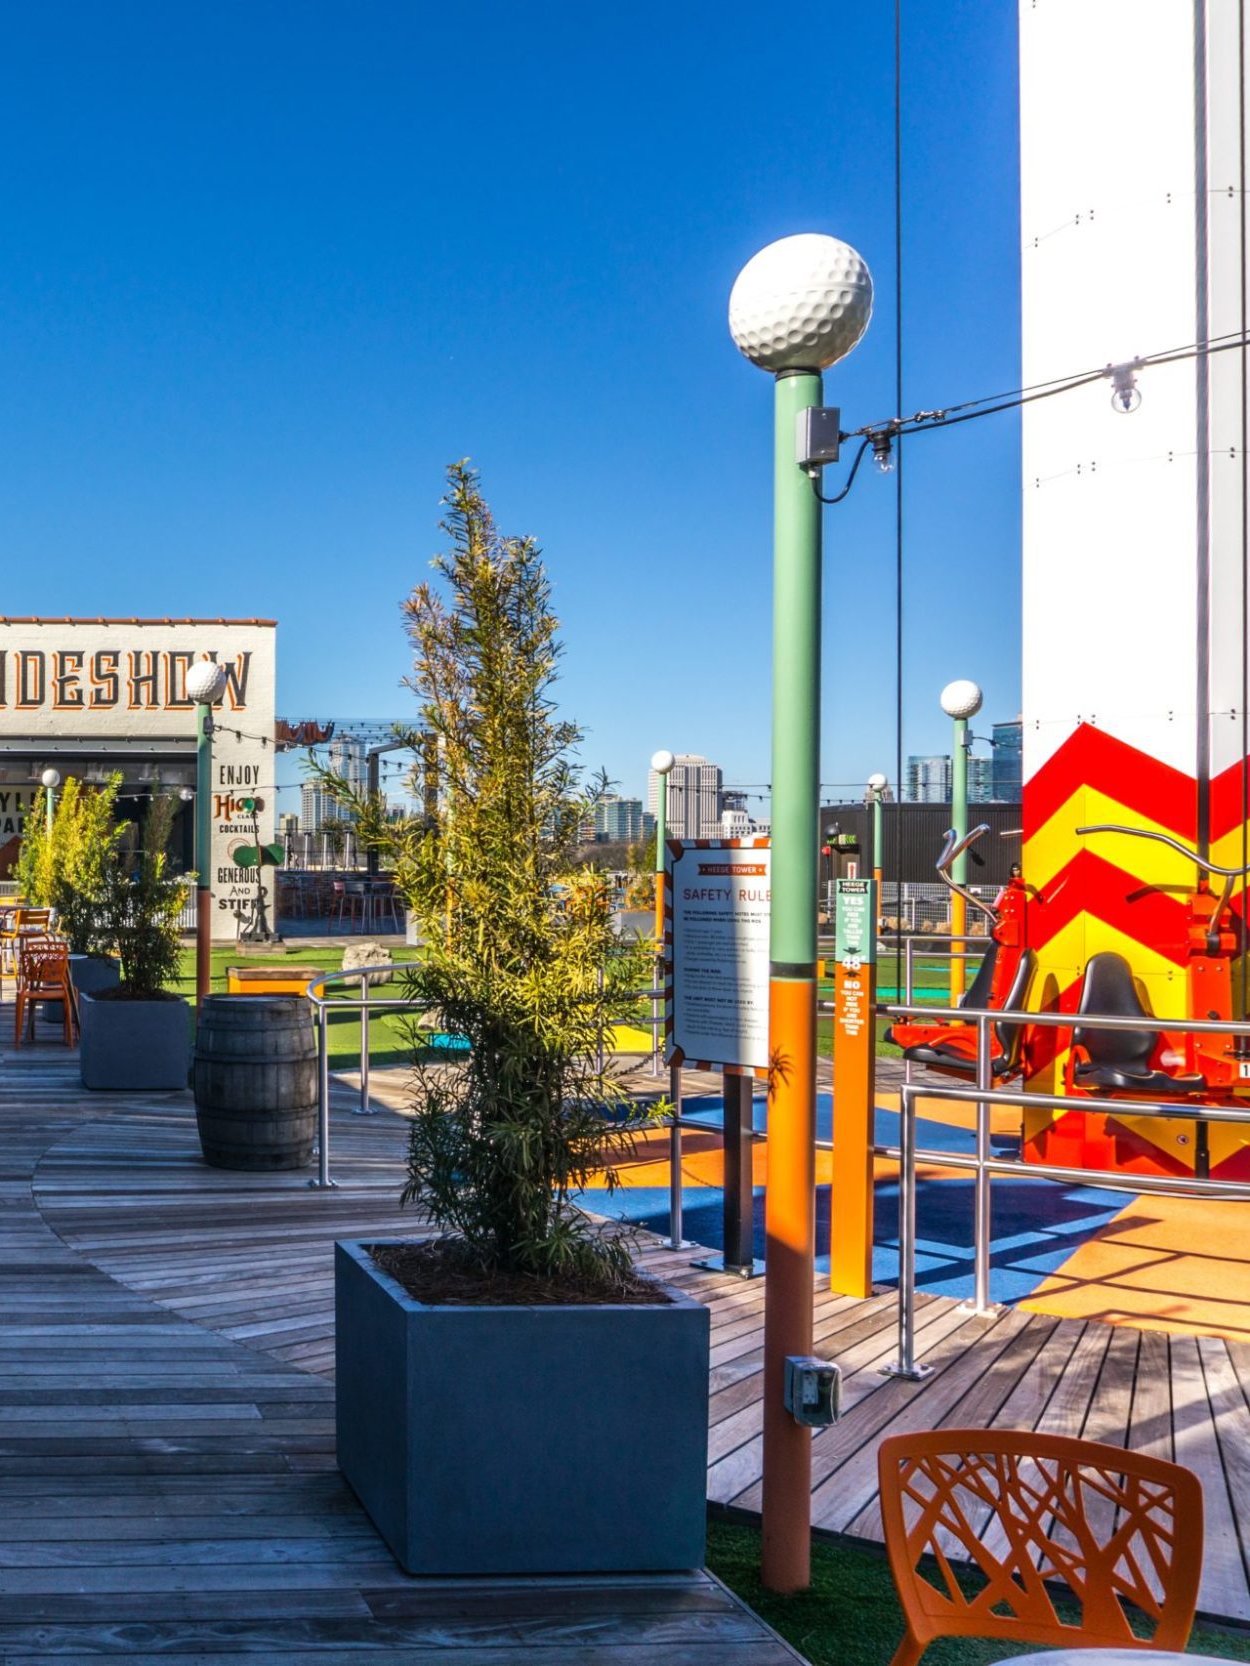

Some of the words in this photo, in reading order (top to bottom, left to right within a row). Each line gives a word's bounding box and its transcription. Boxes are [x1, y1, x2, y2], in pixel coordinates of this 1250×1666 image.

[219, 765, 260, 785] ENJOY
[219, 824, 260, 833] COCKTAILS
[732, 866, 757, 874] TOWER
[218, 867, 260, 883] GENEROUS
[683, 888, 732, 901] SAFETY
[739, 889, 771, 902] RULE
[843, 896, 864, 905] YES
[844, 980, 860, 989] NO
